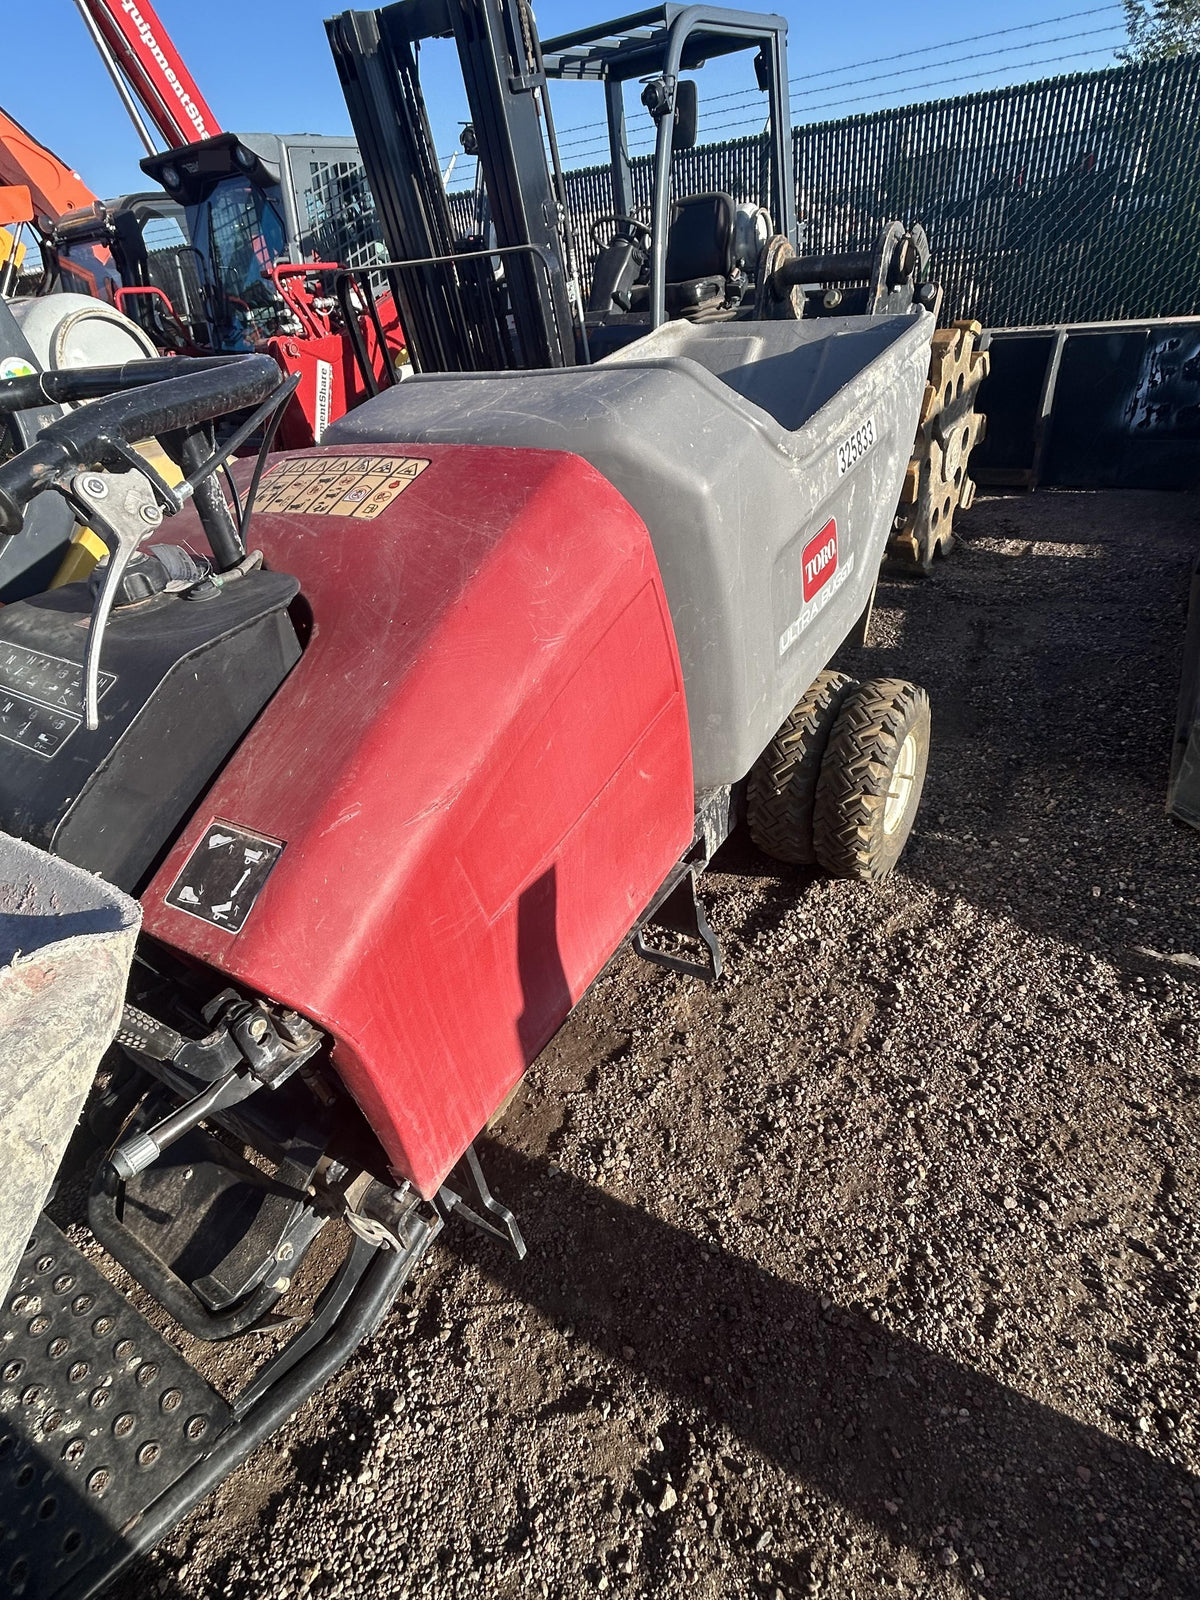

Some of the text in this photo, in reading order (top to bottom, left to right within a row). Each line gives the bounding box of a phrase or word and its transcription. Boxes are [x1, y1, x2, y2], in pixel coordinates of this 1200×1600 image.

[121, 0, 211, 141] quipmentSha
[319, 368, 328, 435] mentShare
[839, 420, 874, 473] 325833
[805, 538, 836, 584] TORO
[781, 602, 819, 650] ULTRA
